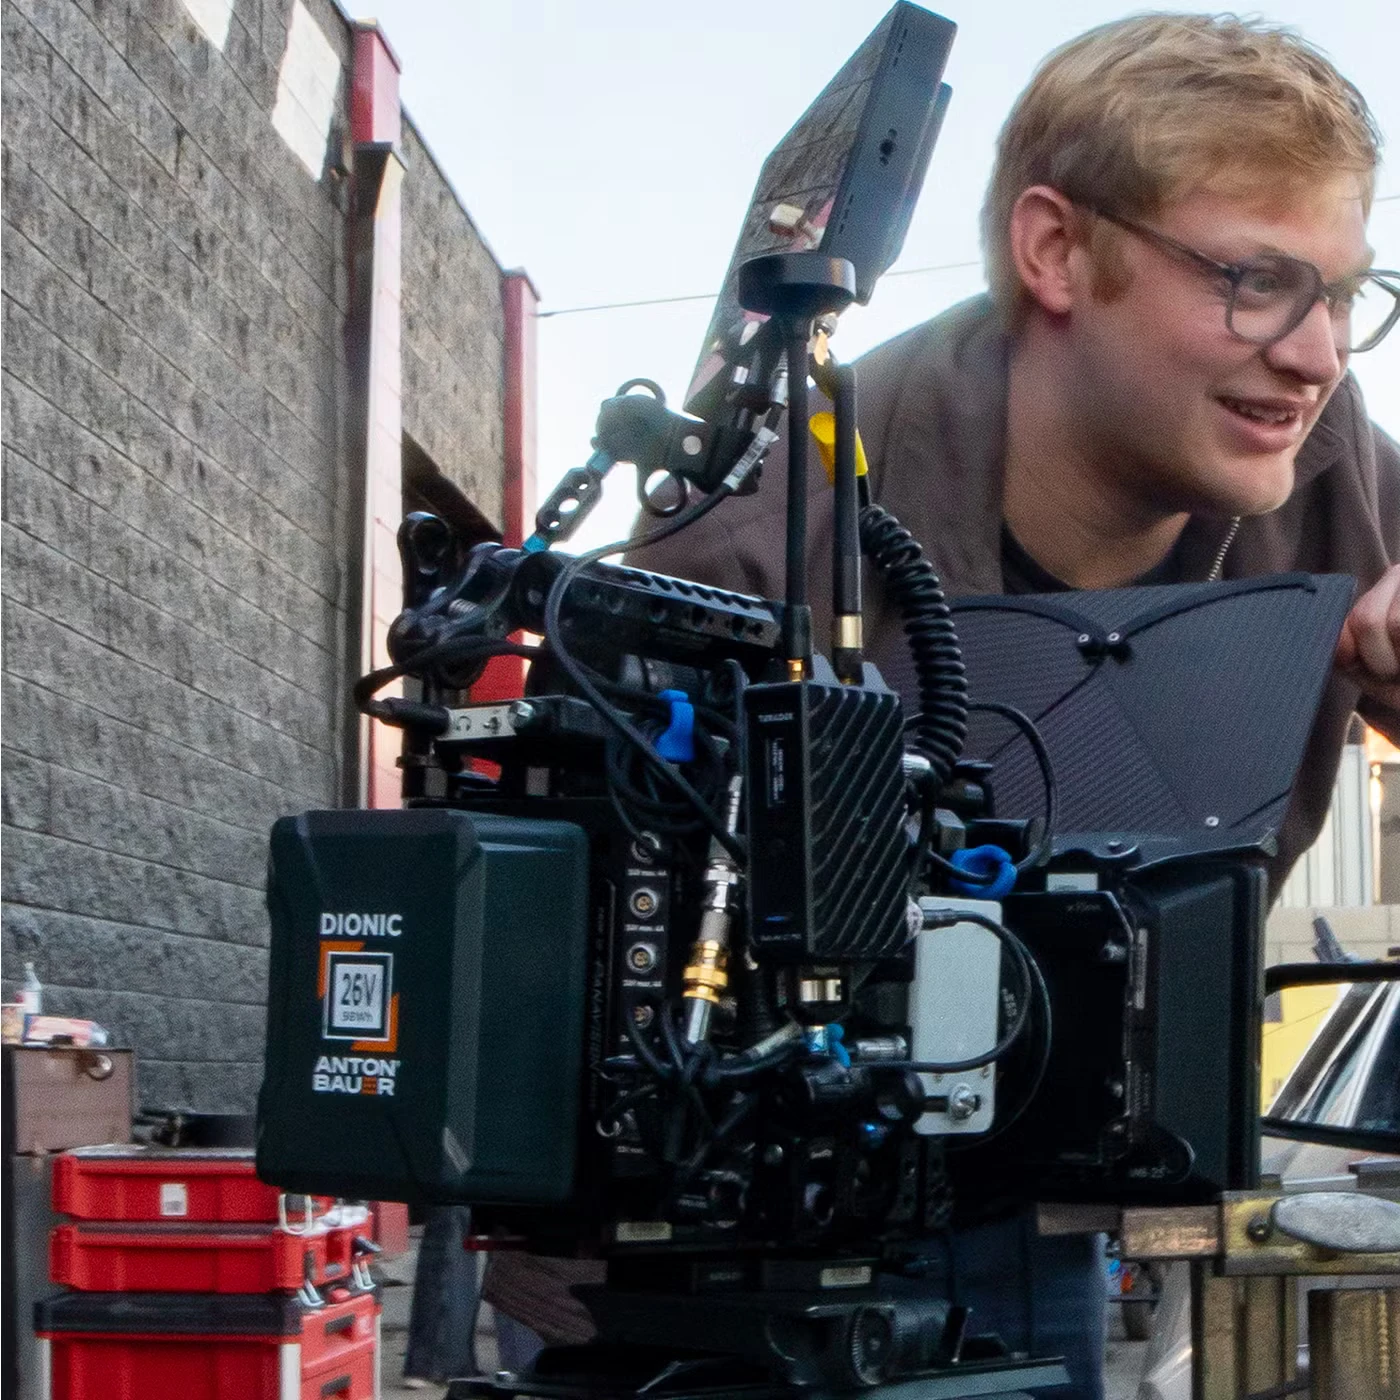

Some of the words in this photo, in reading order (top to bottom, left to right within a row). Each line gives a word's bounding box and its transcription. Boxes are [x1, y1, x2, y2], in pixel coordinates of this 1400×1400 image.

[319, 912, 403, 937] DIONIC
[340, 973, 377, 1007] 26V
[312, 1074, 396, 1097] BAUER
